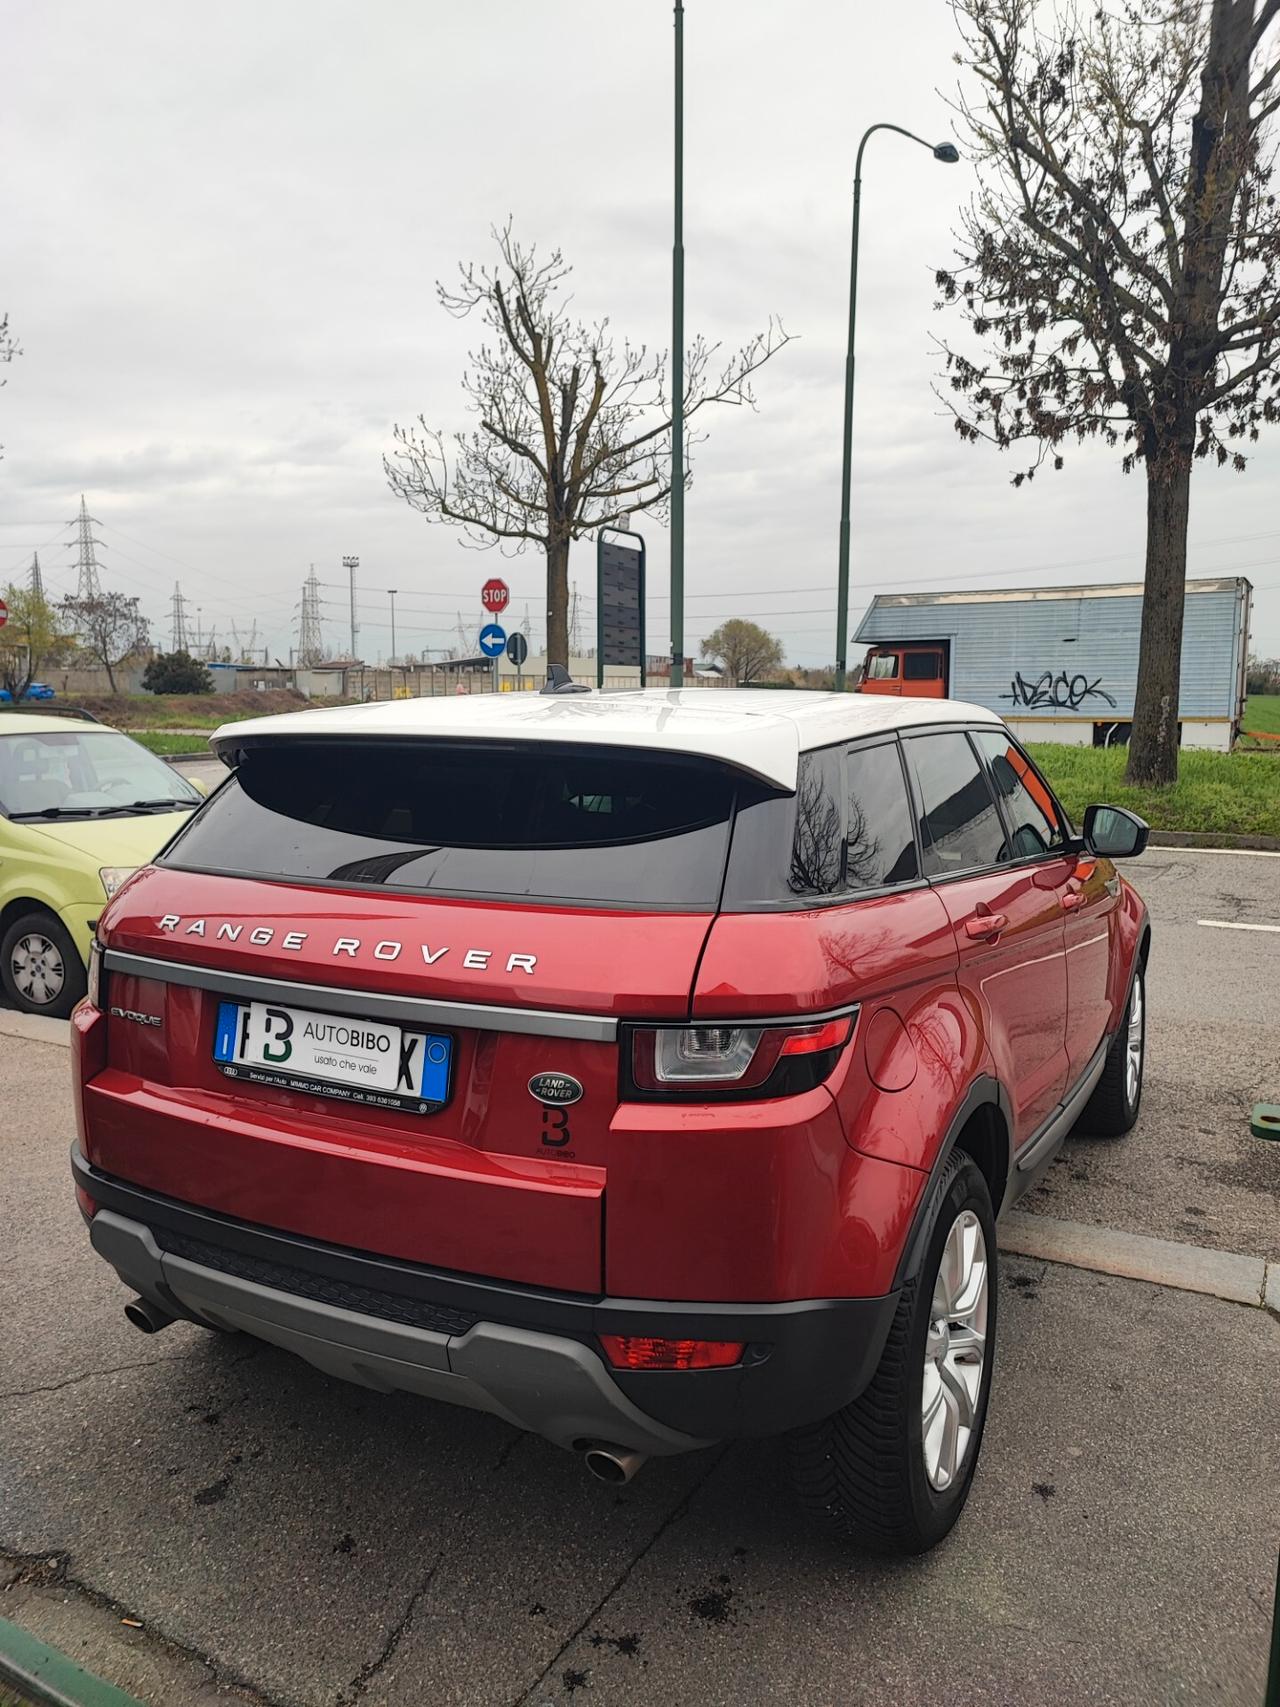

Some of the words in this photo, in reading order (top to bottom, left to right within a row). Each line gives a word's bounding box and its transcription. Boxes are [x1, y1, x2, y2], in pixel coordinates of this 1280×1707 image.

[483, 588, 506, 603] STOP
[159, 915, 308, 950] RANGE
[333, 938, 538, 974] ROVER
[110, 1007, 162, 1026] EVOQUE
[303, 1022, 390, 1052] AUTOBIBO
[314, 1055, 338, 1066] usato
[339, 1057, 357, 1070] che
[358, 1064, 377, 1075] vale
[309, 1083, 321, 1093] CAR
[322, 1086, 351, 1097] COMPANY
[541, 1088, 573, 1099] ROVER
